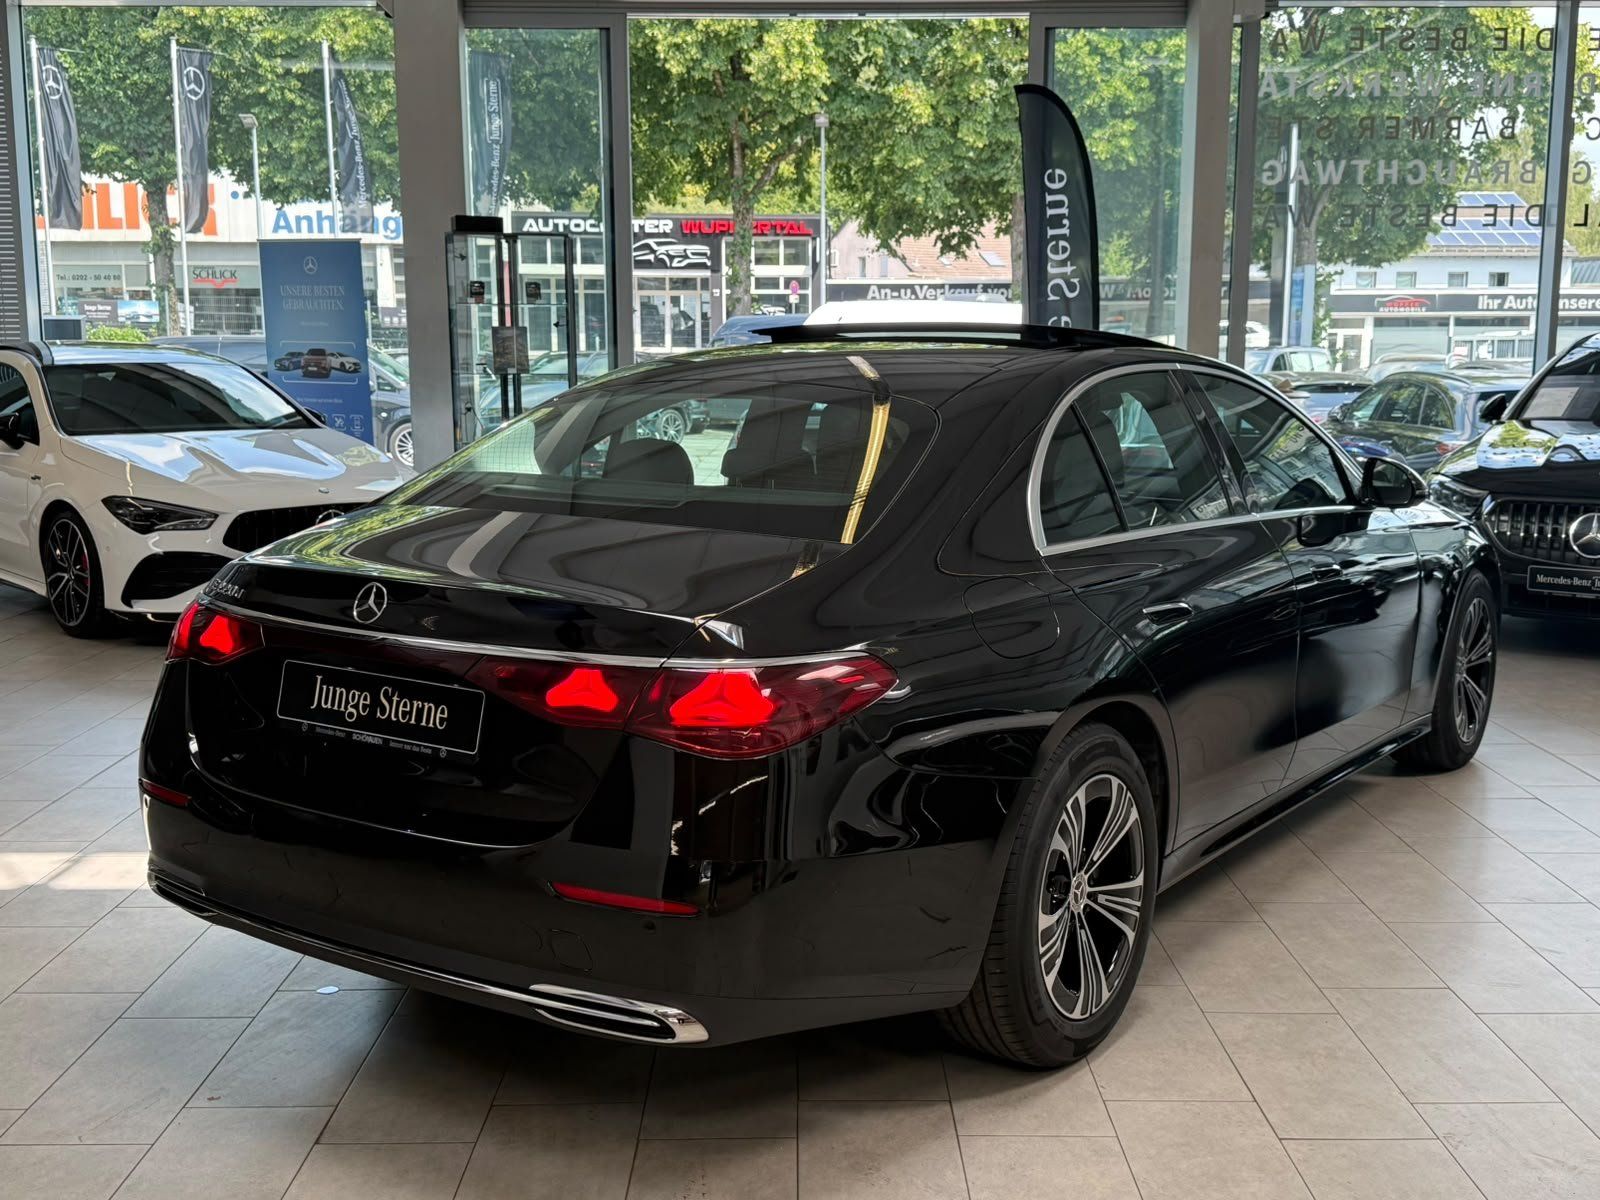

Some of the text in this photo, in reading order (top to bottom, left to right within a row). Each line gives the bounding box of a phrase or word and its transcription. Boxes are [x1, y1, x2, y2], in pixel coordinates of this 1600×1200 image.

[192, 269, 238, 280] SCHLICK
[1477, 295, 1502, 309] Ihr
[1536, 574, 1592, 587] Mercedes-Benz
[310, 674, 449, 730] Junge Sterne
